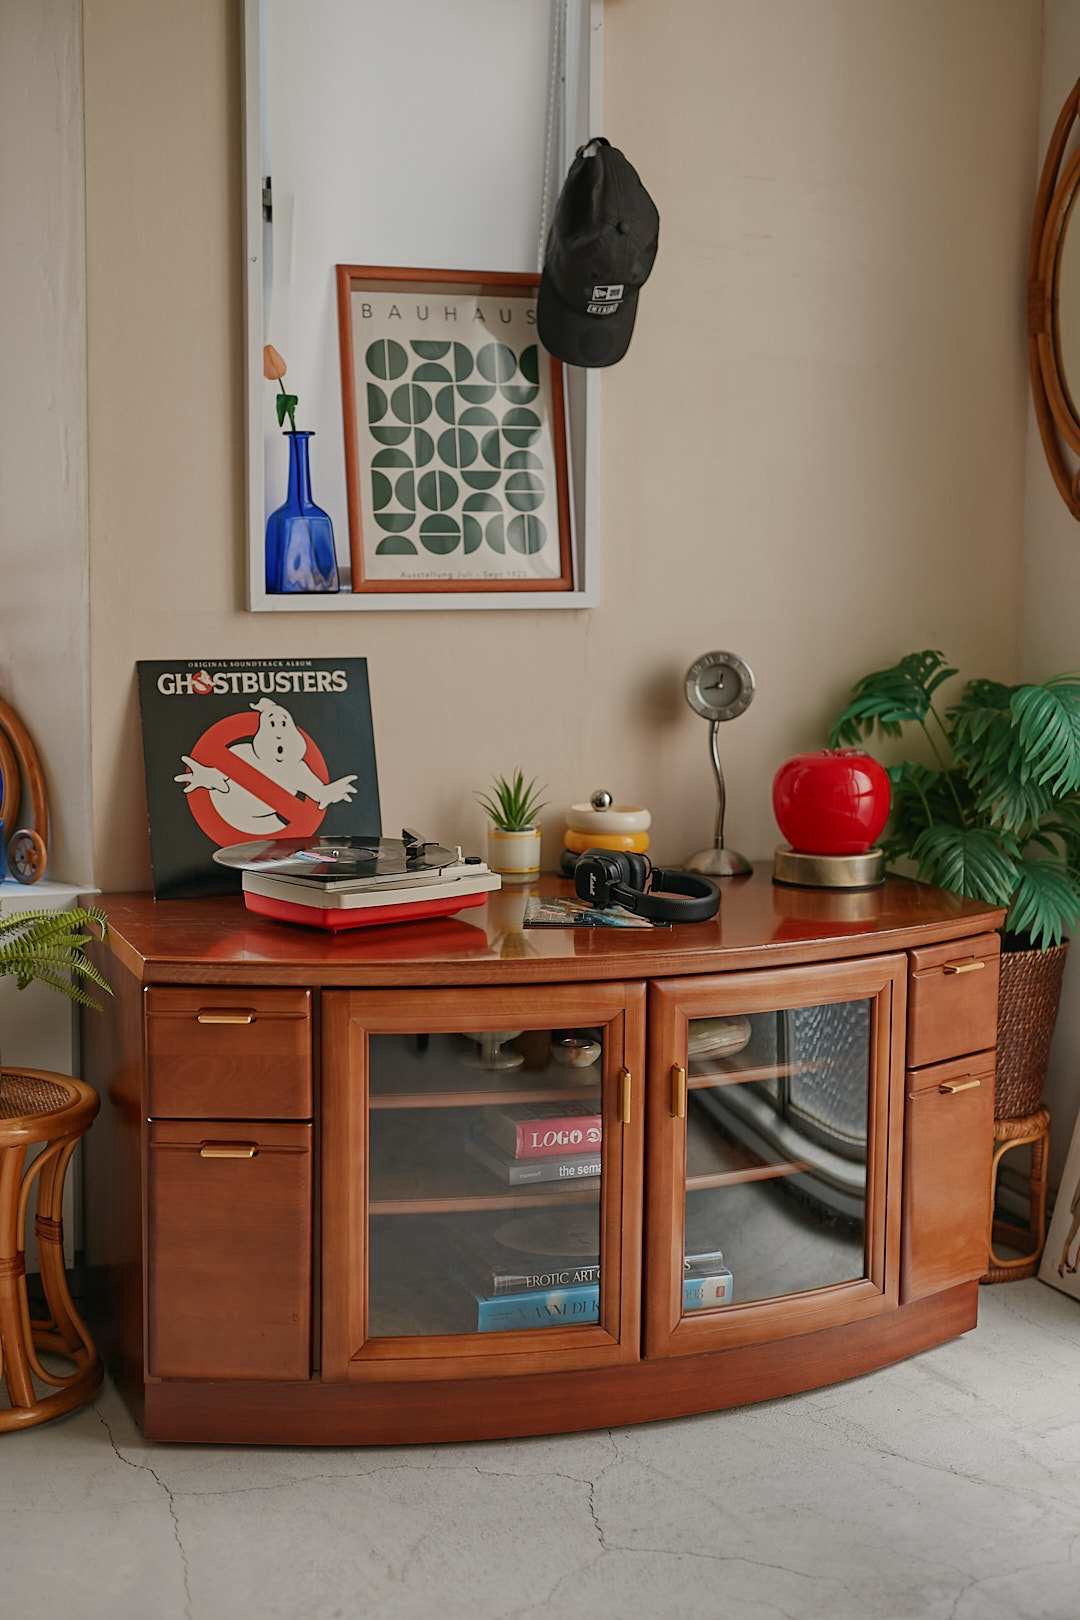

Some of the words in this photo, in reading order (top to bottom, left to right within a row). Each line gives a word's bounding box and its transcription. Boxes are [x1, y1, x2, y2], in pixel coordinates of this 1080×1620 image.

[361, 303, 537, 325] BAUHAUS
[531, 1129, 583, 1148] LOGO
[559, 1165, 575, 1177] the
[526, 1272, 570, 1288] EROTIC
[572, 1269, 595, 1282] ART
